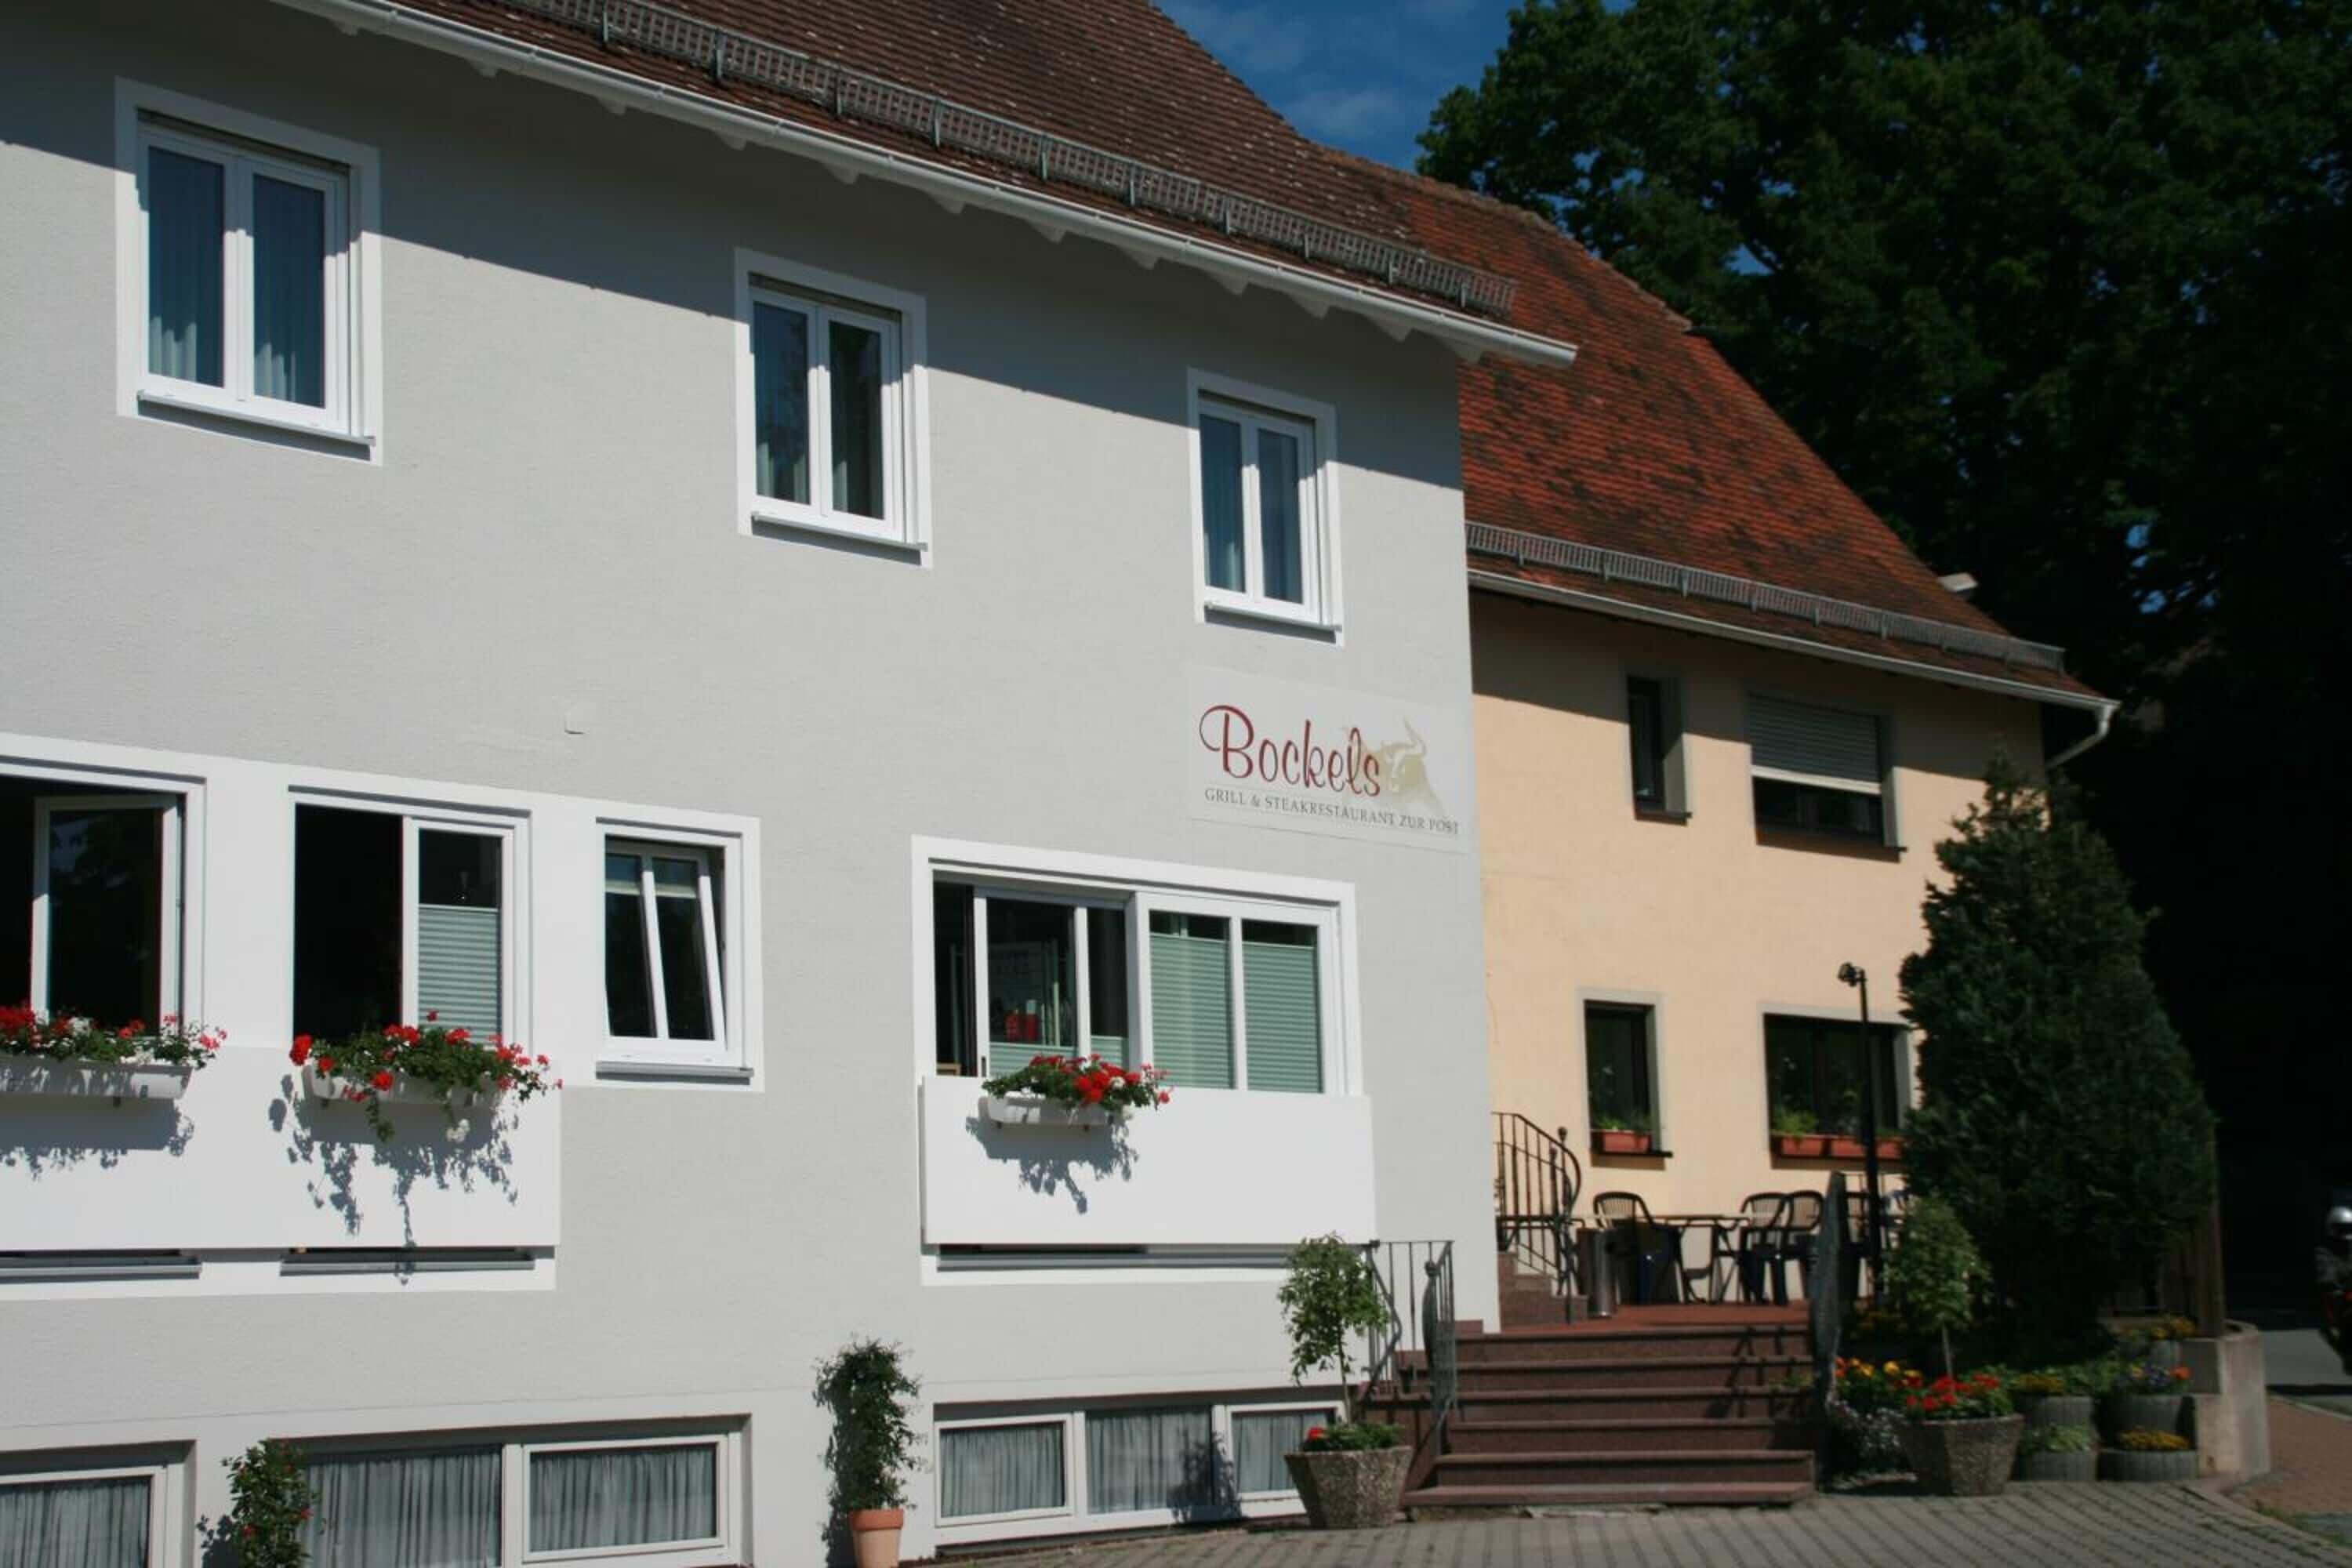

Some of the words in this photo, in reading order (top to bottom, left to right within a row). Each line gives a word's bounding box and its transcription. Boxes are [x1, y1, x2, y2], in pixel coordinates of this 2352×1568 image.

[1199, 705, 1381, 797] Bockels
[1204, 788, 1247, 805] GRILL
[1250, 794, 1261, 808] &
[1265, 796, 1395, 826] STEAKRESTAURANT
[1399, 815, 1425, 829] ZUR
[1428, 818, 1460, 834] POST
